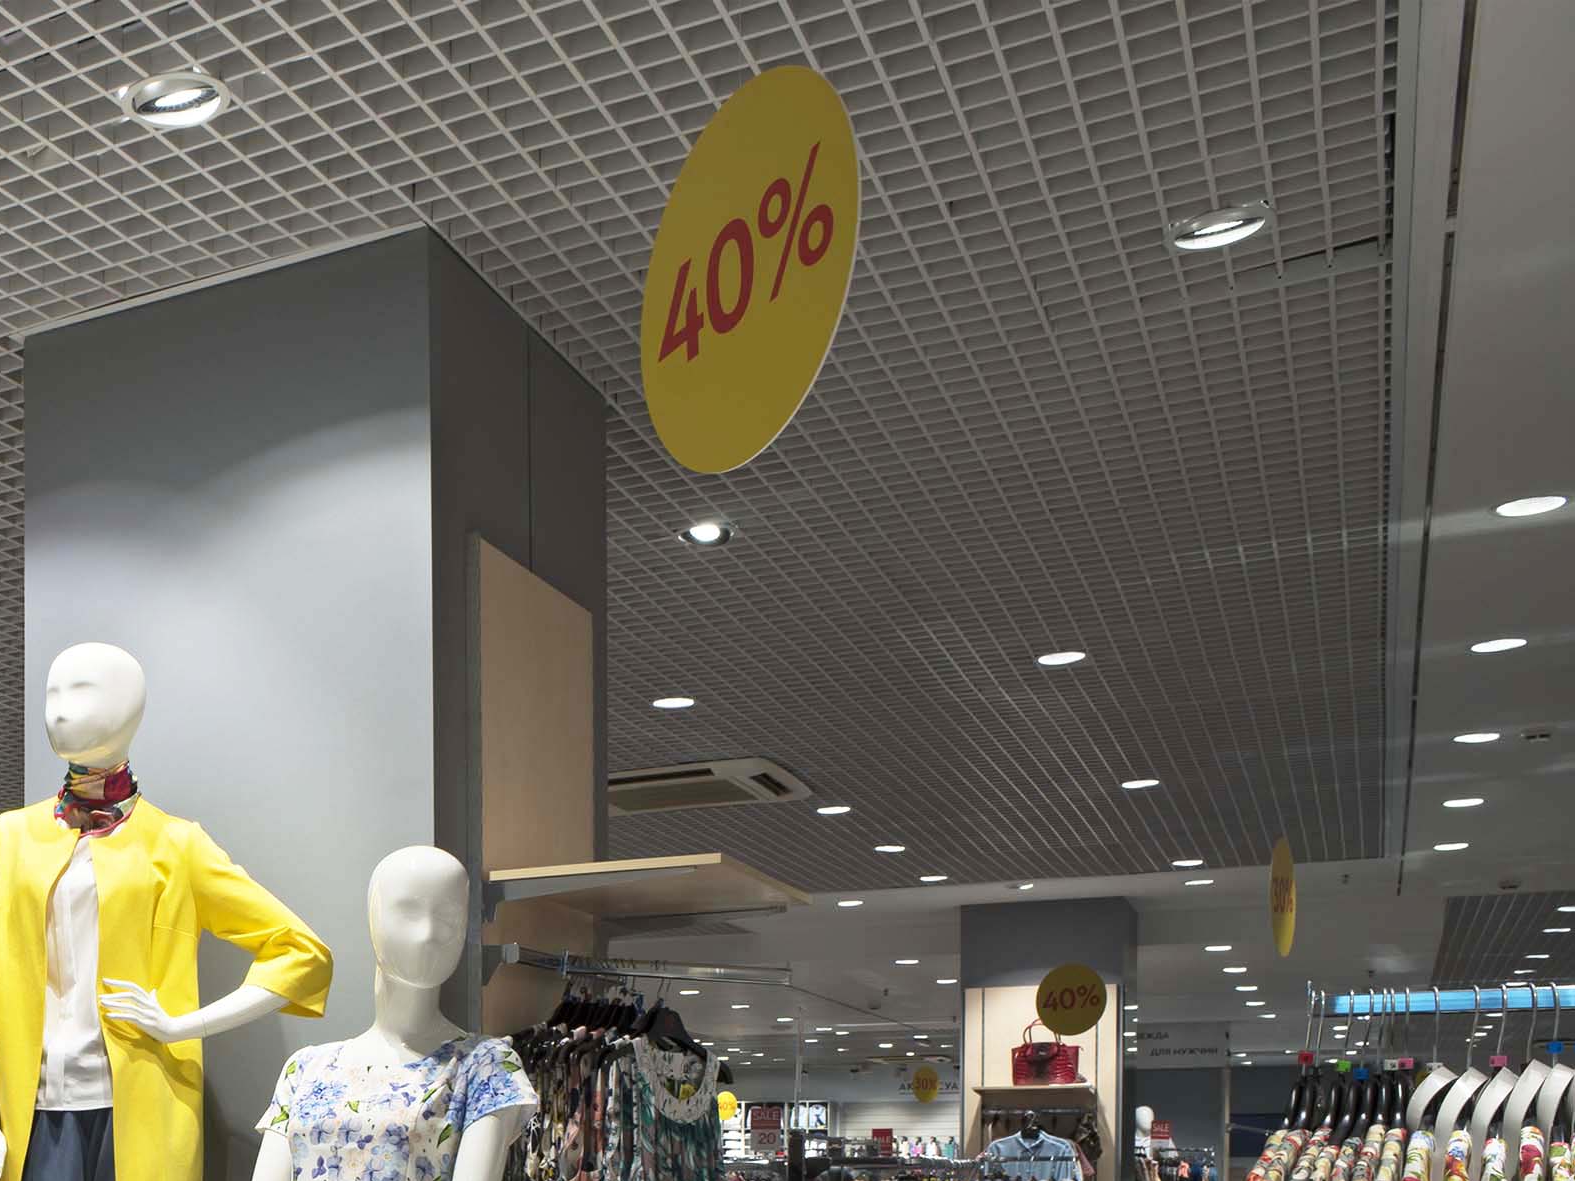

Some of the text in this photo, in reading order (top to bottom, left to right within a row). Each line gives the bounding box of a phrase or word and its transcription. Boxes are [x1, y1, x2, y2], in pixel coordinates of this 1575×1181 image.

[658, 141, 834, 363] 40%
[1041, 984, 1101, 1011] 40%
[752, 1109, 780, 1121] SALE
